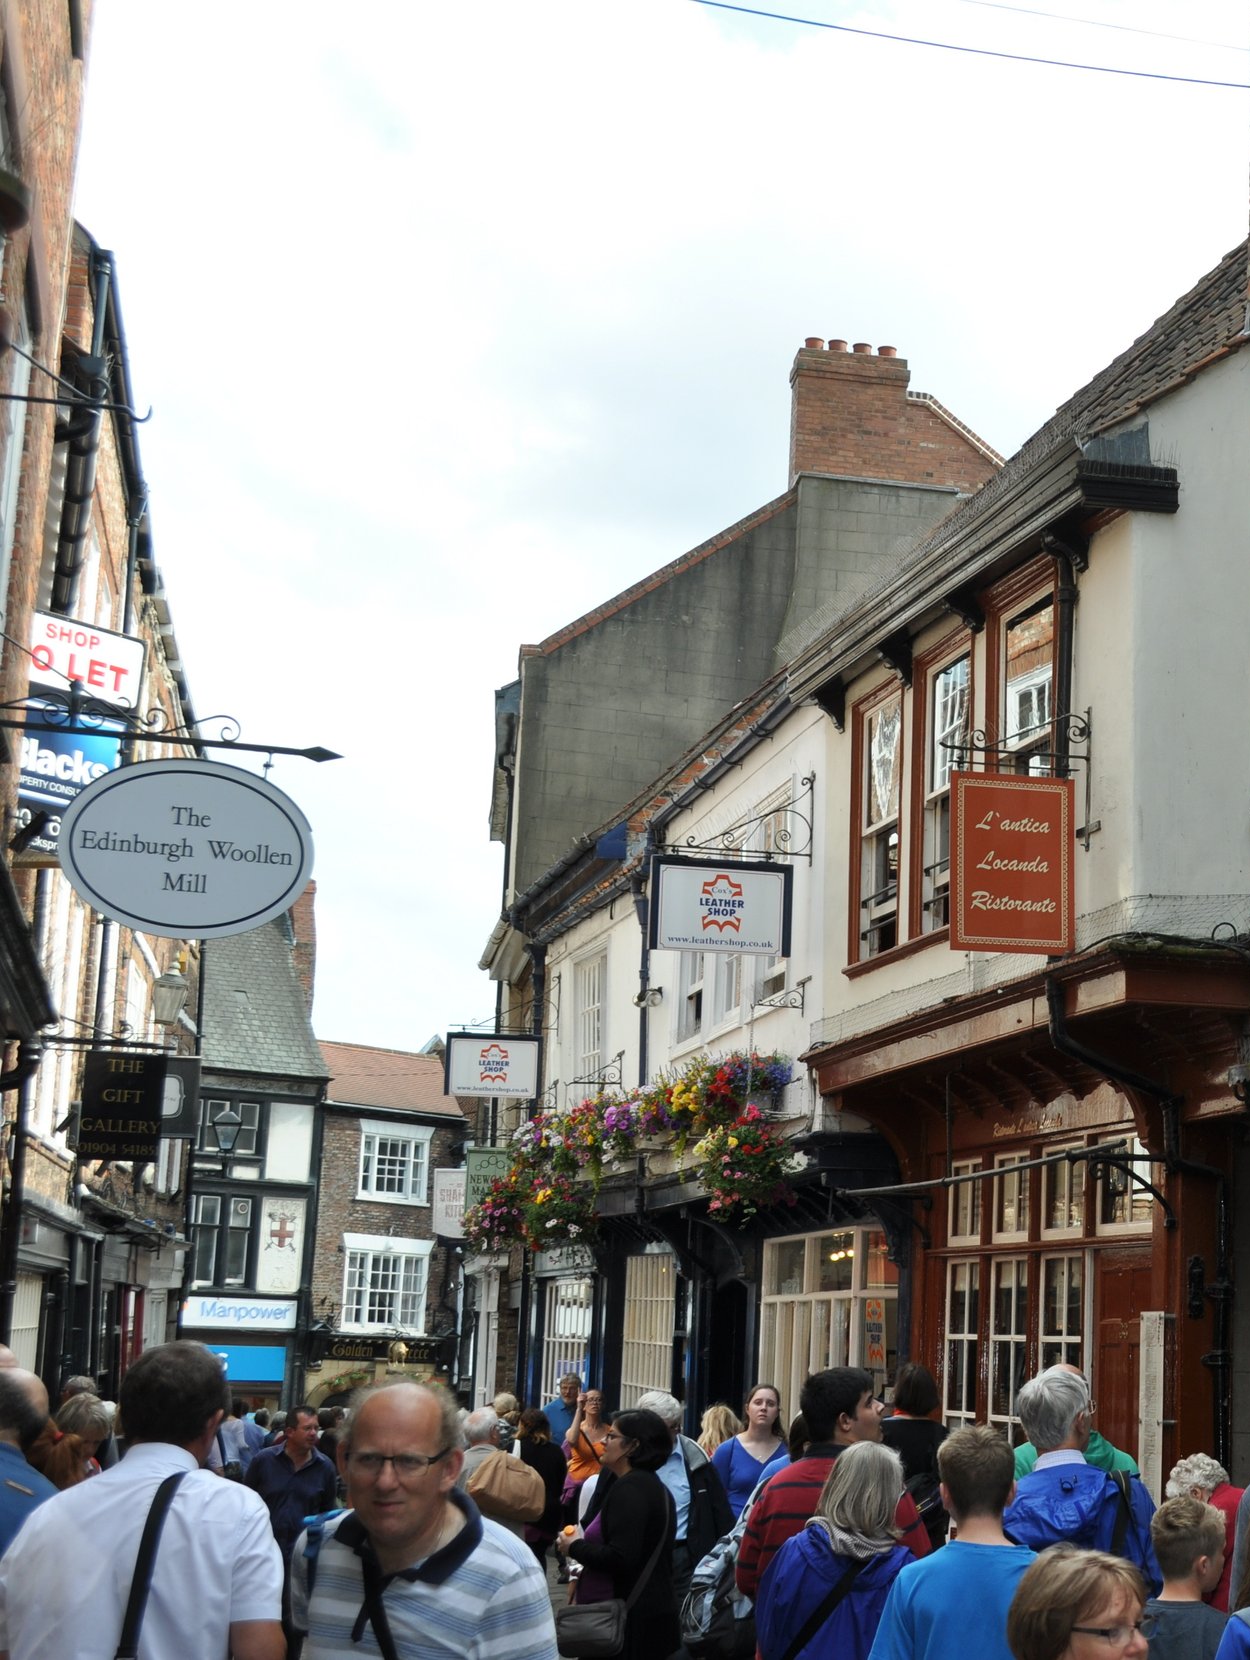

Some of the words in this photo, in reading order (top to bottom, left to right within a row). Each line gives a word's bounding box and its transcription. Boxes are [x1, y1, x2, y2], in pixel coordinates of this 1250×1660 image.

[46, 623, 100, 650] SHOP
[32, 644, 54, 671] O
[67, 653, 129, 692] LET
[171, 806, 211, 828] The
[80, 830, 194, 862] Edinburgh
[207, 839, 293, 866] Woollen
[976, 850, 1050, 873] Locanda
[161, 872, 207, 894] Mill
[711, 887, 733, 895] Cox's
[699, 898, 745, 909] LEATHER
[970, 890, 1057, 914] Ristorante
[708, 907, 736, 917] SHOP
[668, 936, 773, 948] www.leathershop.co.uk
[107, 1059, 144, 1074] THE
[102, 1088, 144, 1104] GIFT
[80, 1117, 160, 1135] GALLERY
[201, 1301, 290, 1322] Manpower
[332, 1343, 373, 1357] Golden
